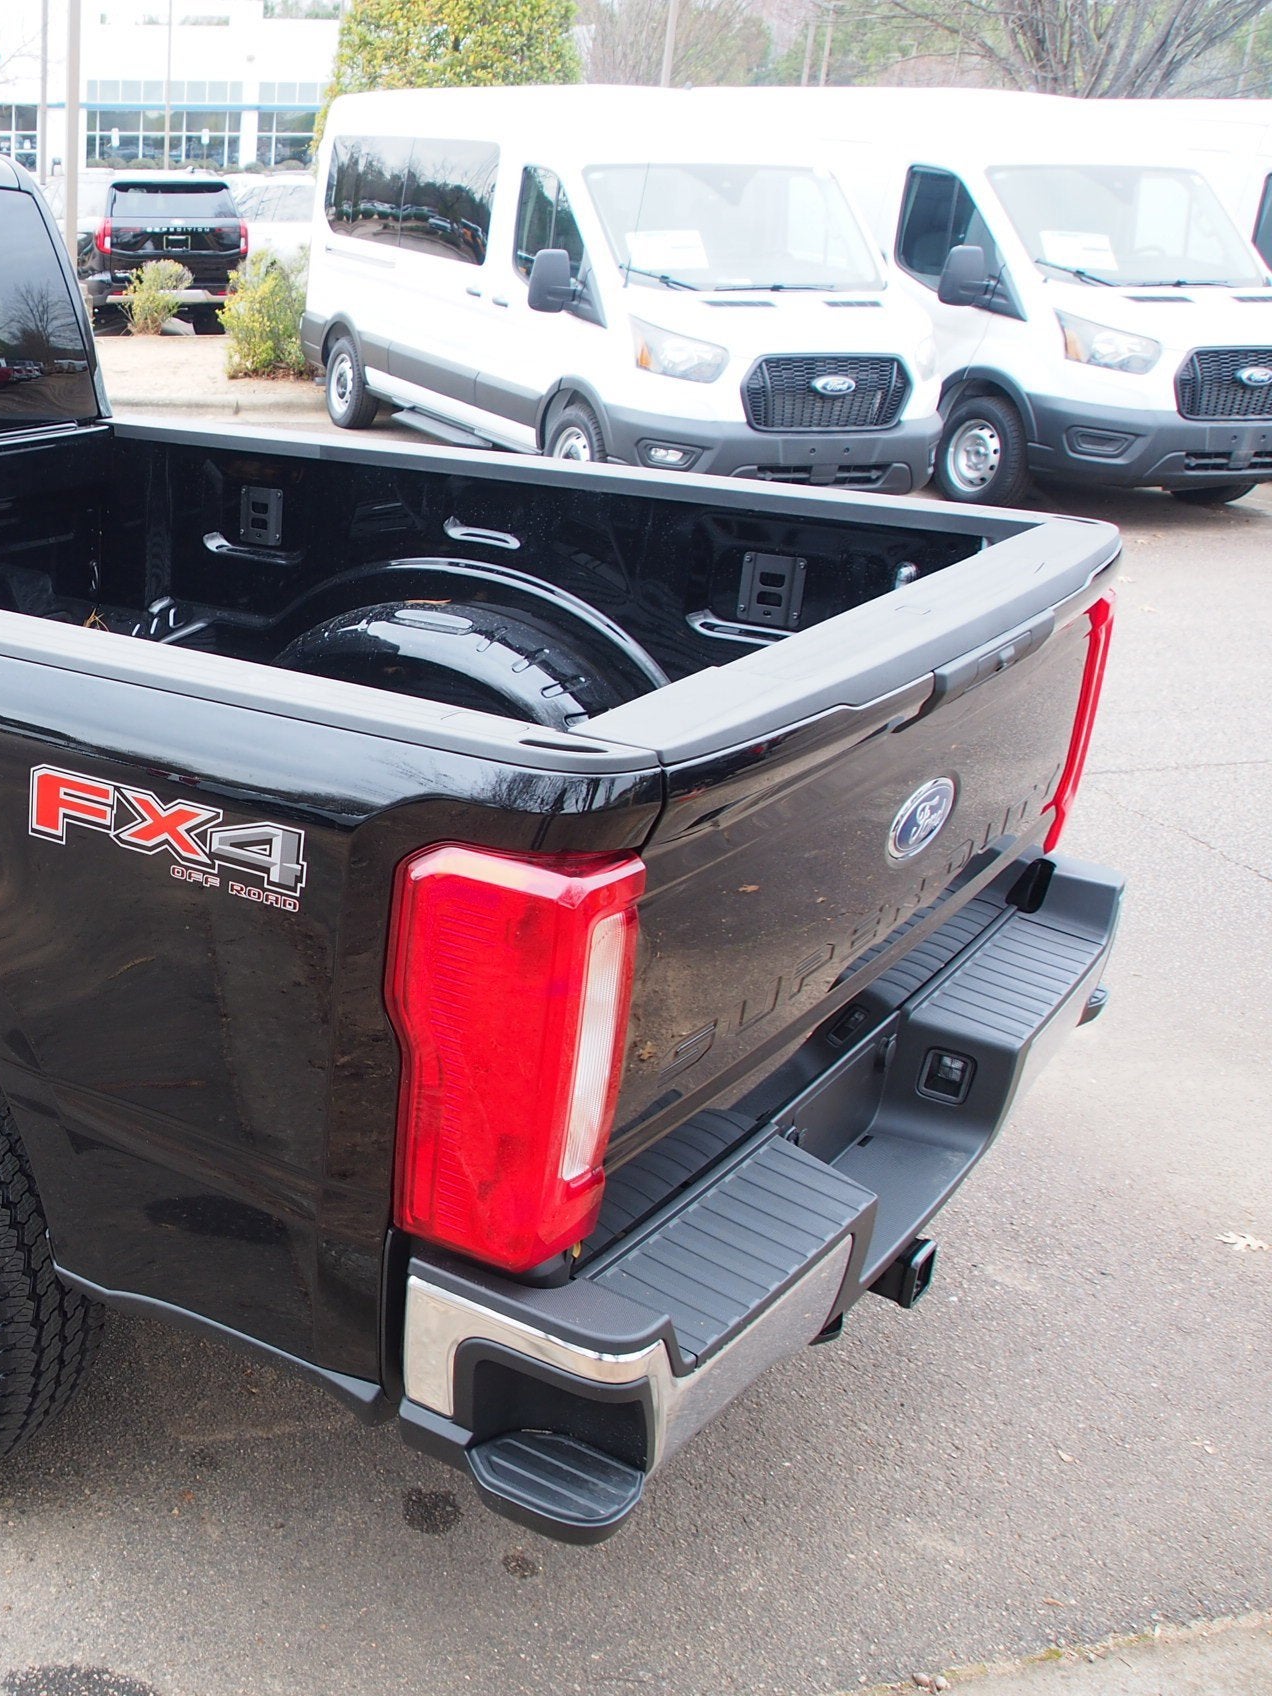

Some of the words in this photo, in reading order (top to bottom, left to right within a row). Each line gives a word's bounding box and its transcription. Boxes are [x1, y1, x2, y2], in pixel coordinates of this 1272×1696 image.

[29, 764, 307, 897] FX4
[908, 795, 947, 845] Ford
[170, 865, 220, 888] OFF
[229, 881, 300, 913] ROAD
[657, 876, 927, 1090] SUPER
